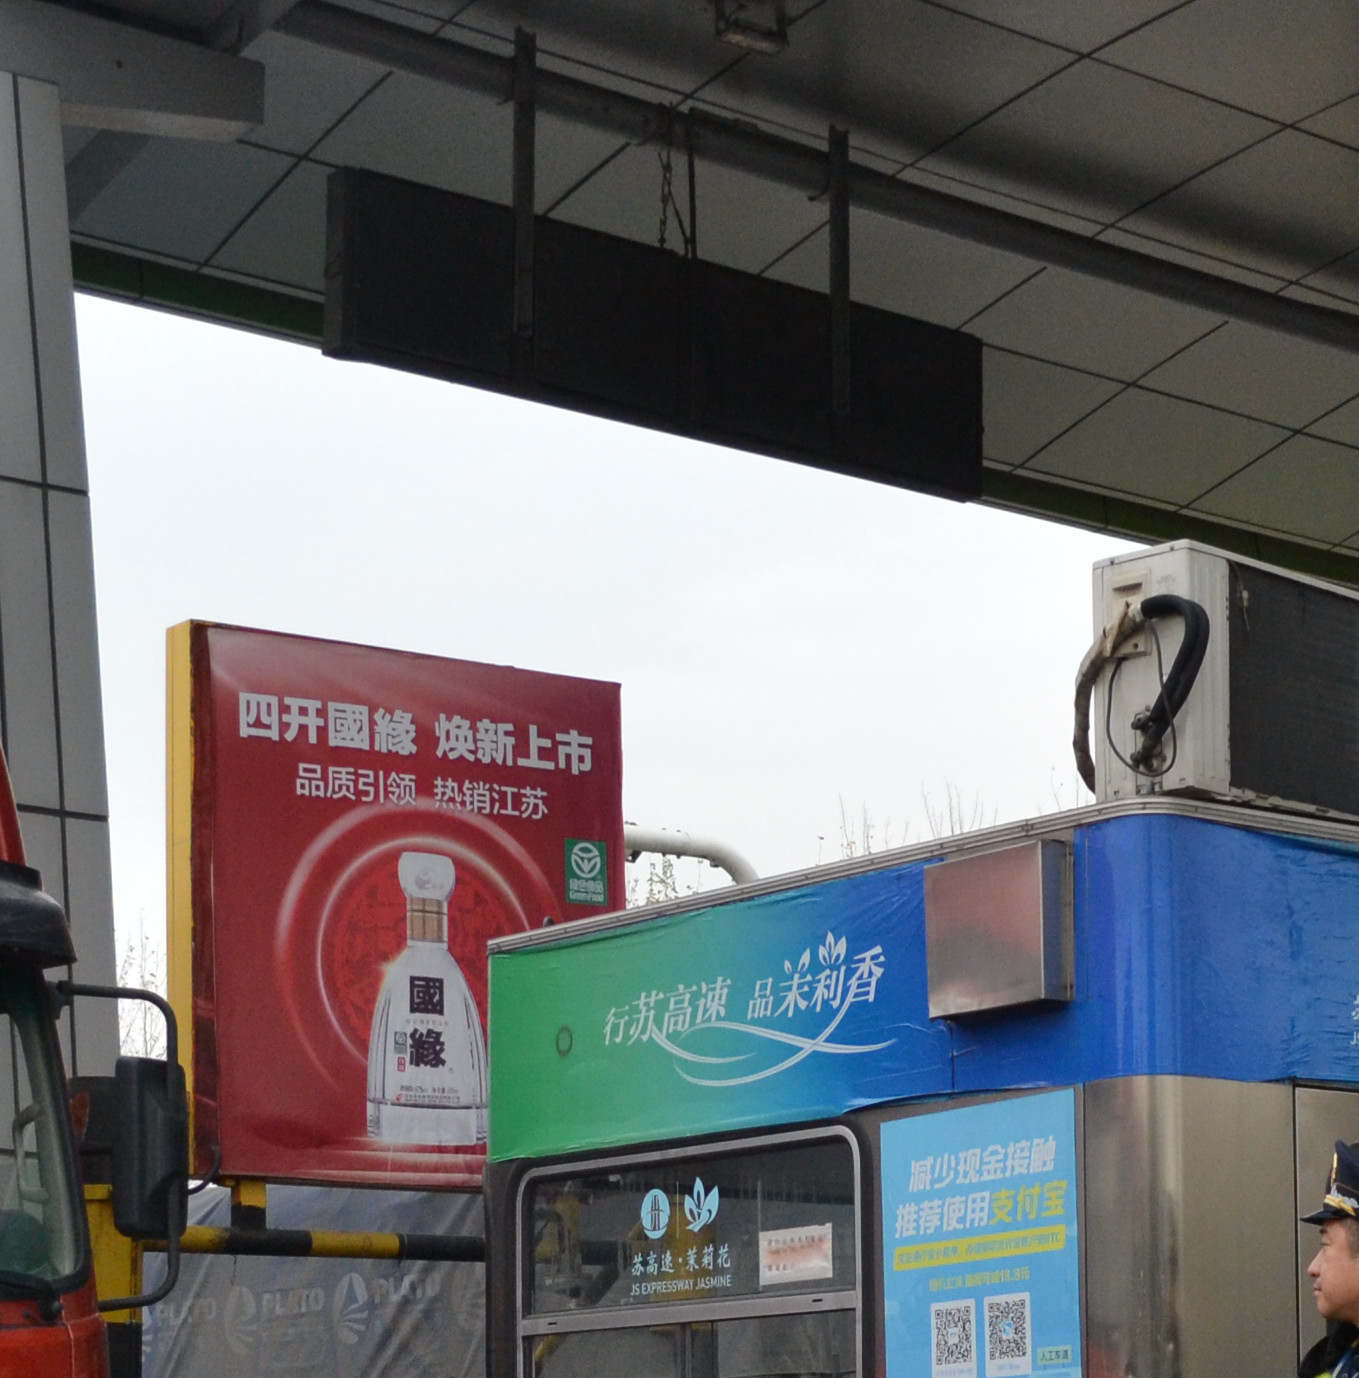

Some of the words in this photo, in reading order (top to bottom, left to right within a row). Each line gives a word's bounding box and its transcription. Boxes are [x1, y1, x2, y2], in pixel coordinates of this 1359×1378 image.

[435, 713, 593, 775] 焕新上市
[296, 762, 417, 806] 品质引领
[434, 776, 548, 820] 热销江苏
[603, 976, 732, 1046] 行苏高速
[909, 1136, 1056, 1192] 减少现金接触
[895, 1180, 1068, 1238] 推荐使用支付宝
[630, 1284, 640, 1296] JS
[642, 1279, 694, 1295] EXPRESSWAY
[696, 1275, 732, 1290] JASMINE
